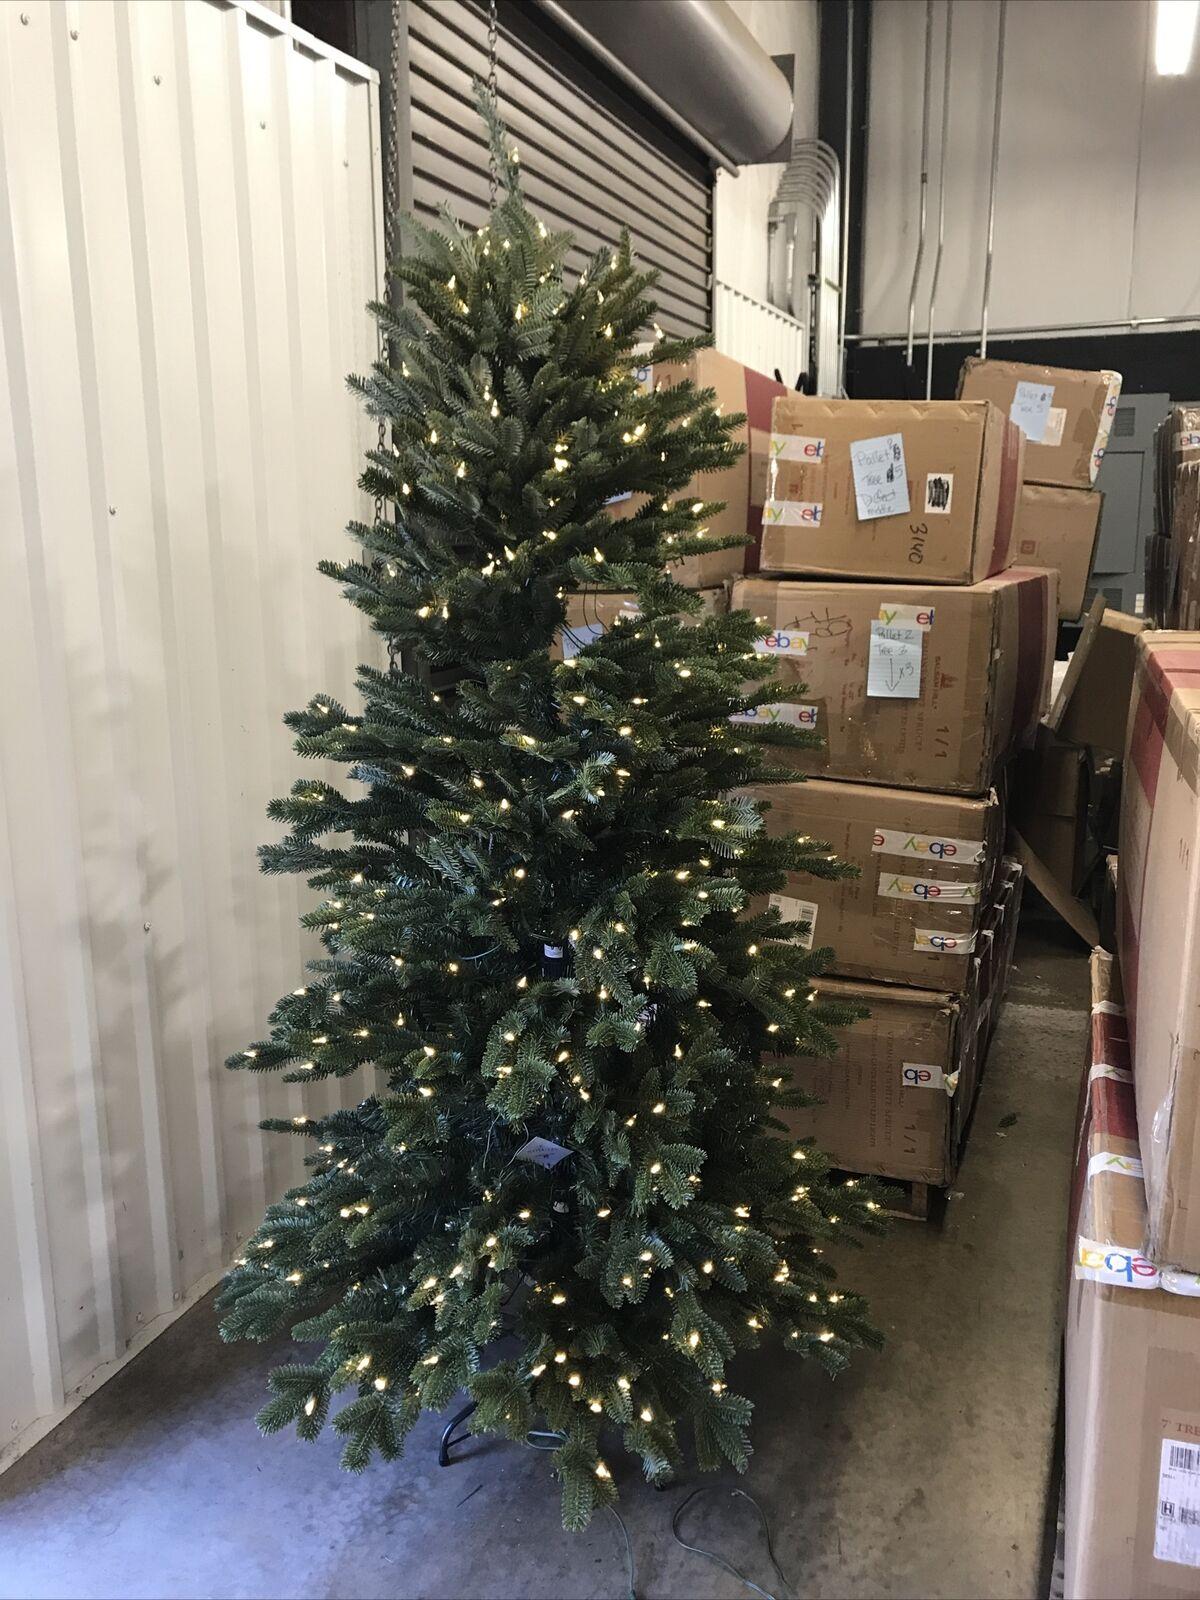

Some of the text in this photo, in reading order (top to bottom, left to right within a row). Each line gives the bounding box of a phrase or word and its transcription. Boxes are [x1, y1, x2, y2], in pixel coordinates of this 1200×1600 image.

[855, 449, 890, 466] Pallet
[895, 464, 904, 479] 5
[908, 523, 928, 565] 3140
[875, 627, 902, 641] Pallet
[904, 836, 957, 859] ebay
[887, 878, 941, 899] ebay
[916, 935, 957, 951] eba
[1079, 1250, 1157, 1283] eba
